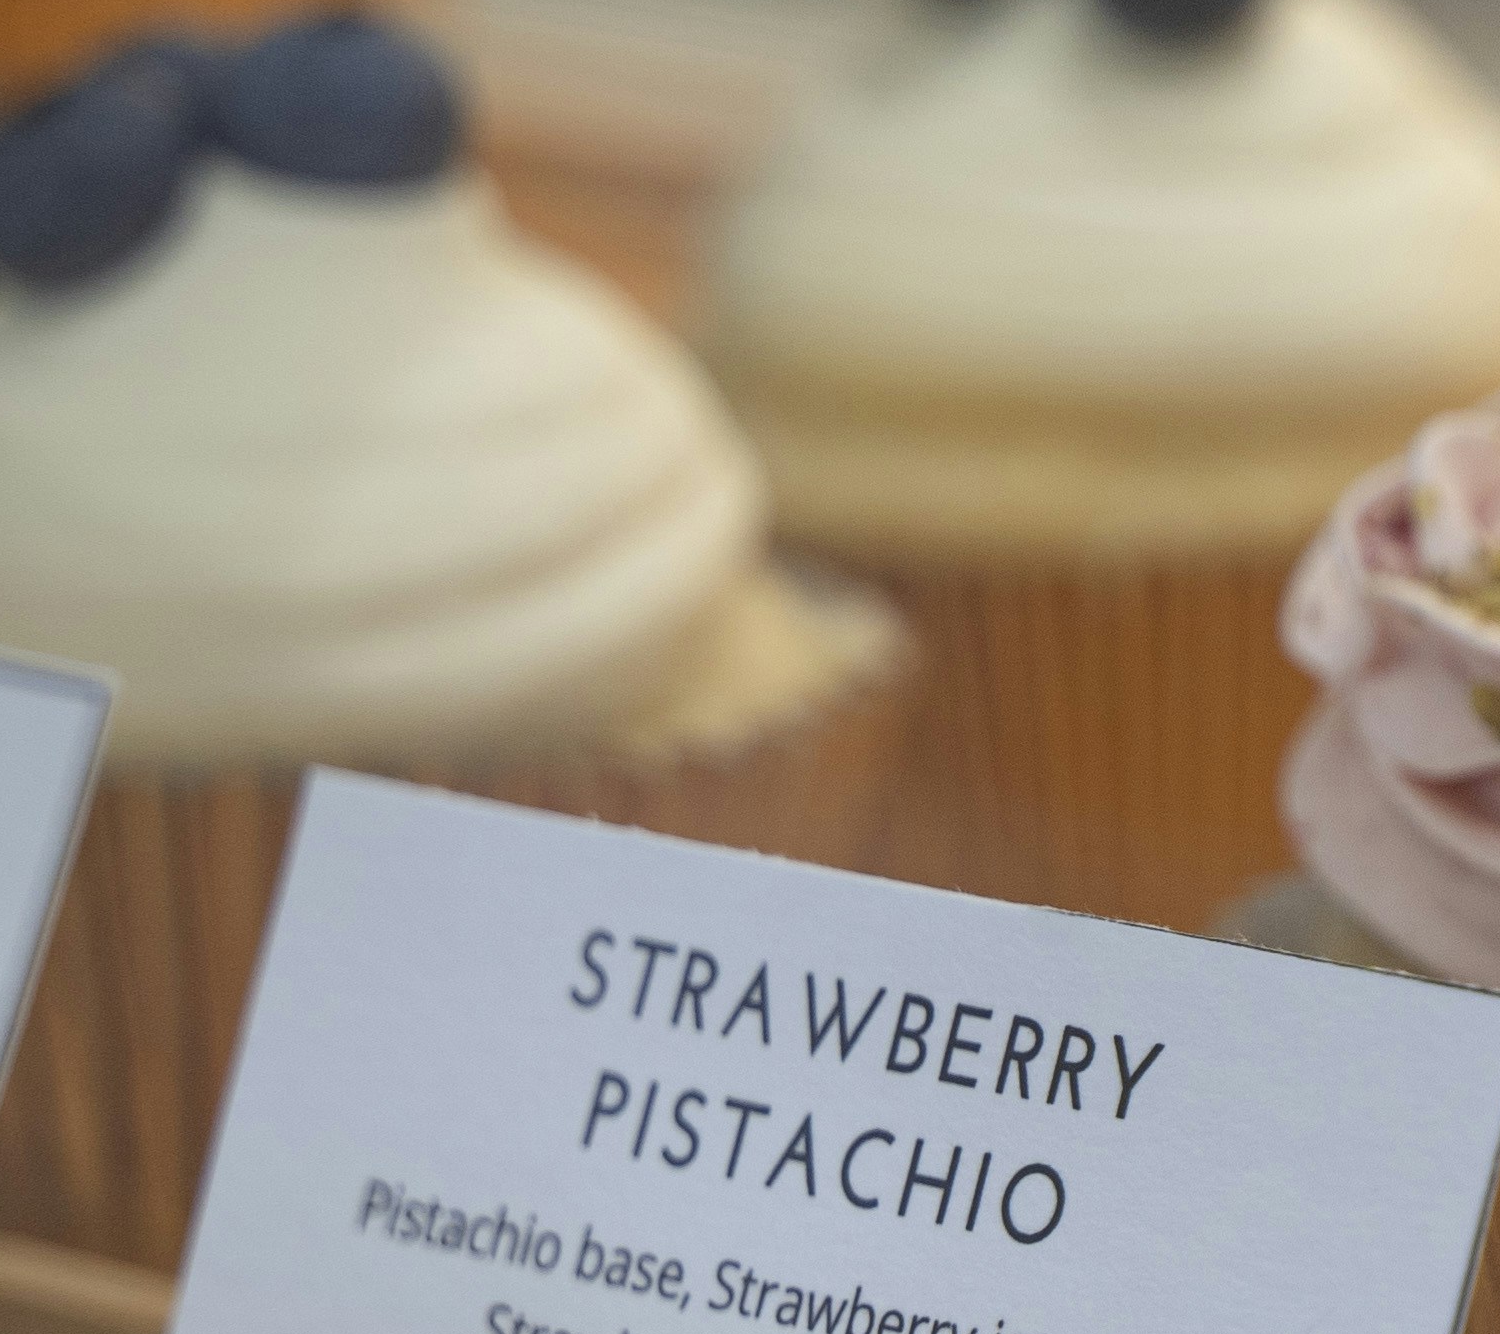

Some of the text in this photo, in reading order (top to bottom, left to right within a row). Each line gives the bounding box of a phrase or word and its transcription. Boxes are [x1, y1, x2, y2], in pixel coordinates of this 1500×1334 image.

[569, 927, 1165, 1121] STRAWBERRY
[358, 1176, 561, 1272] Pistachio
[573, 1226, 691, 1310] base,
[581, 1070, 1068, 1246] PISTACHIO
